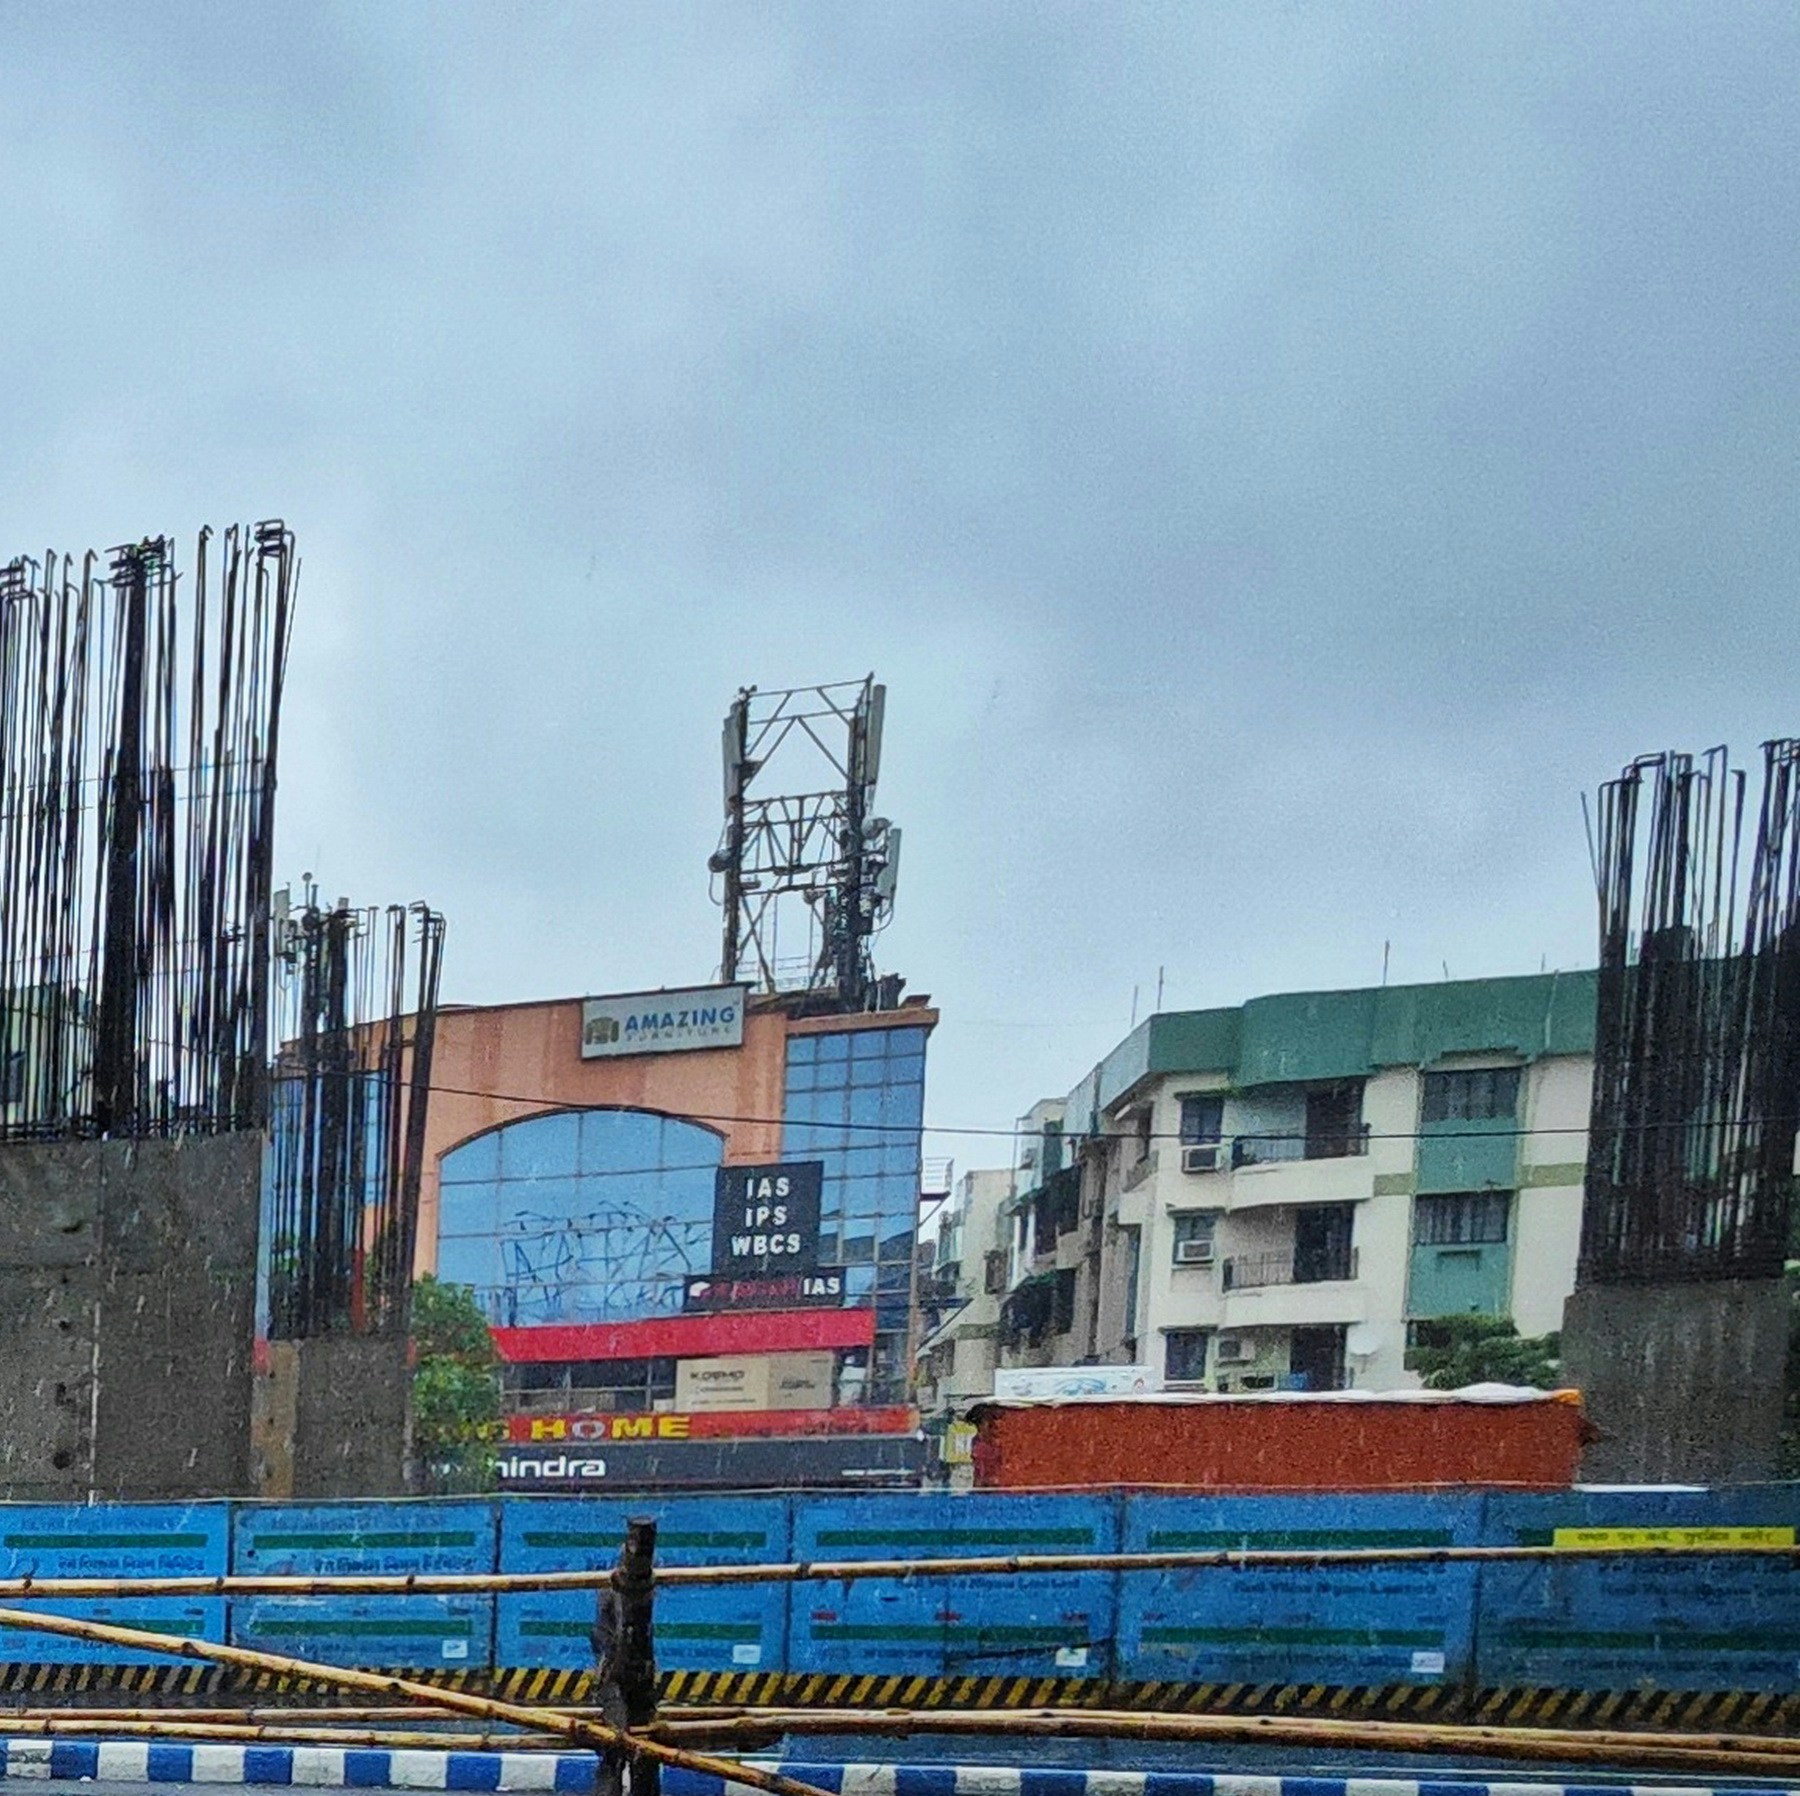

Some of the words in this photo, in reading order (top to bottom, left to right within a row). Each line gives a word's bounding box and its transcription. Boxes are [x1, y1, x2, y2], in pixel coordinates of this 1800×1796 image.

[625, 1006, 735, 1031] AMAZING
[746, 1177, 790, 1199] IAS
[745, 1206, 788, 1227] IPS
[731, 1233, 801, 1256] WBCS
[802, 1277, 841, 1295] IAS
[531, 1416, 690, 1440] HOME
